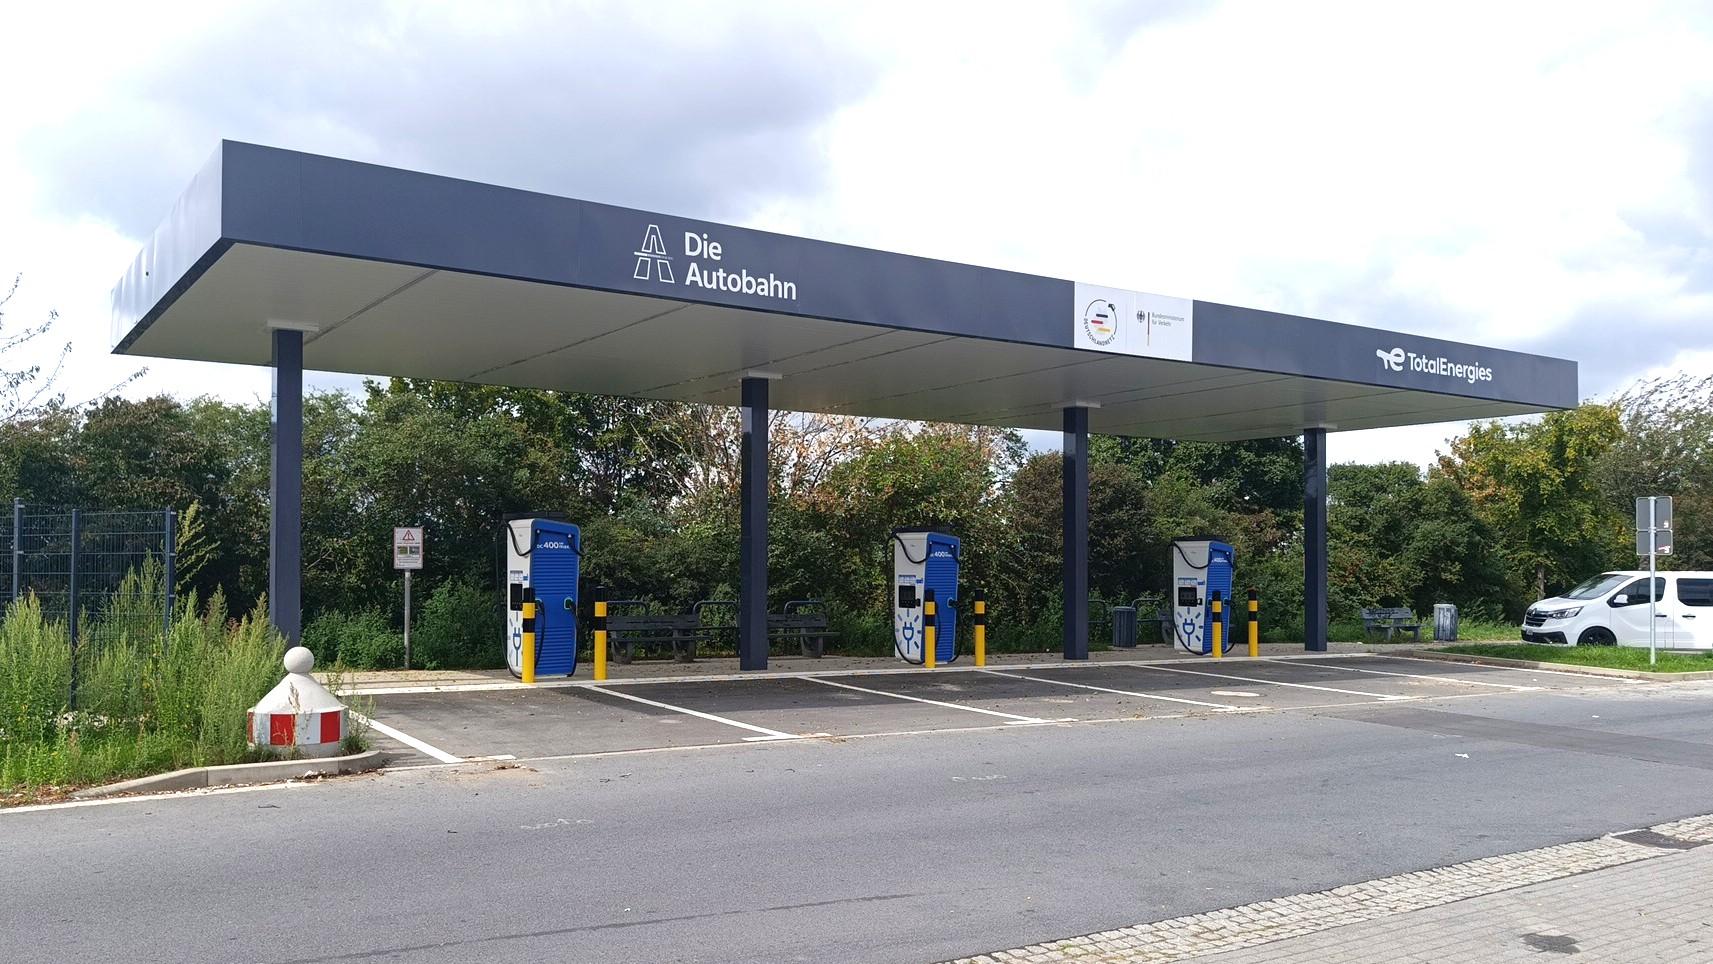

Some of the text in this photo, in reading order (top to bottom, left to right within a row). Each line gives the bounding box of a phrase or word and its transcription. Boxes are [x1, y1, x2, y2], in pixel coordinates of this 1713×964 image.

[684, 232, 722, 261] Die
[685, 262, 797, 300] Autobahn
[1407, 352, 1493, 384] TotalEnergies
